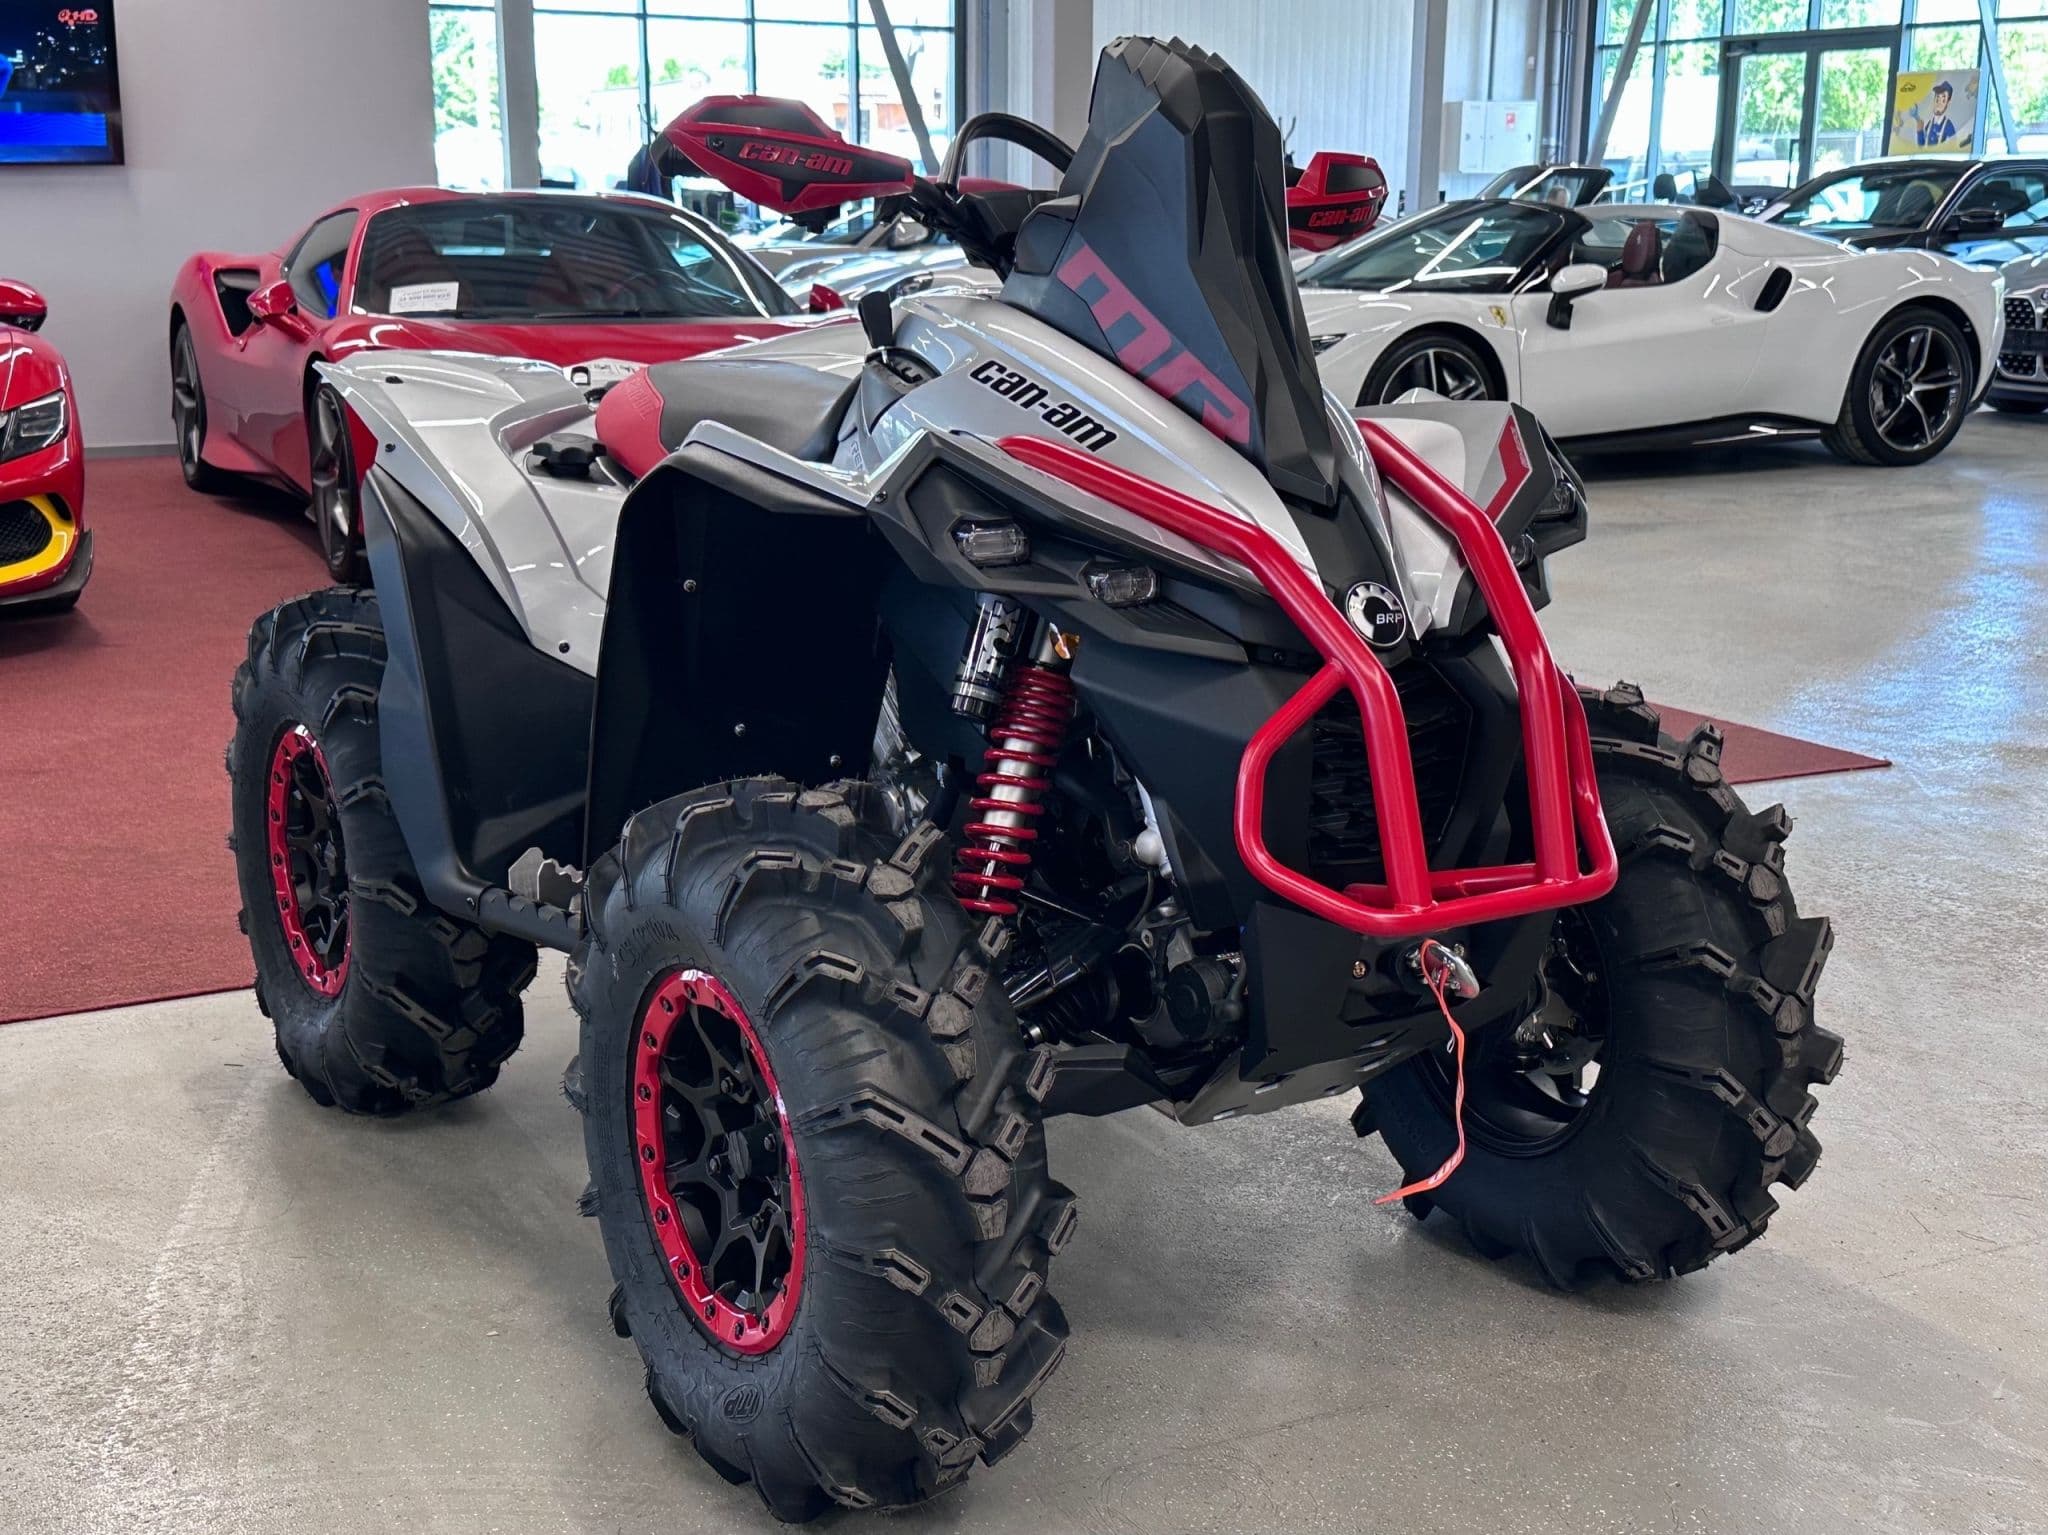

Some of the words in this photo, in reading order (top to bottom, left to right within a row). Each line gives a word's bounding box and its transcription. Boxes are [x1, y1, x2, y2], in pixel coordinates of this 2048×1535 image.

[739, 142, 853, 176] can-am
[969, 359, 1118, 453] can-am
[977, 601, 1020, 677] FOX
[1376, 613, 1403, 625] BRP
